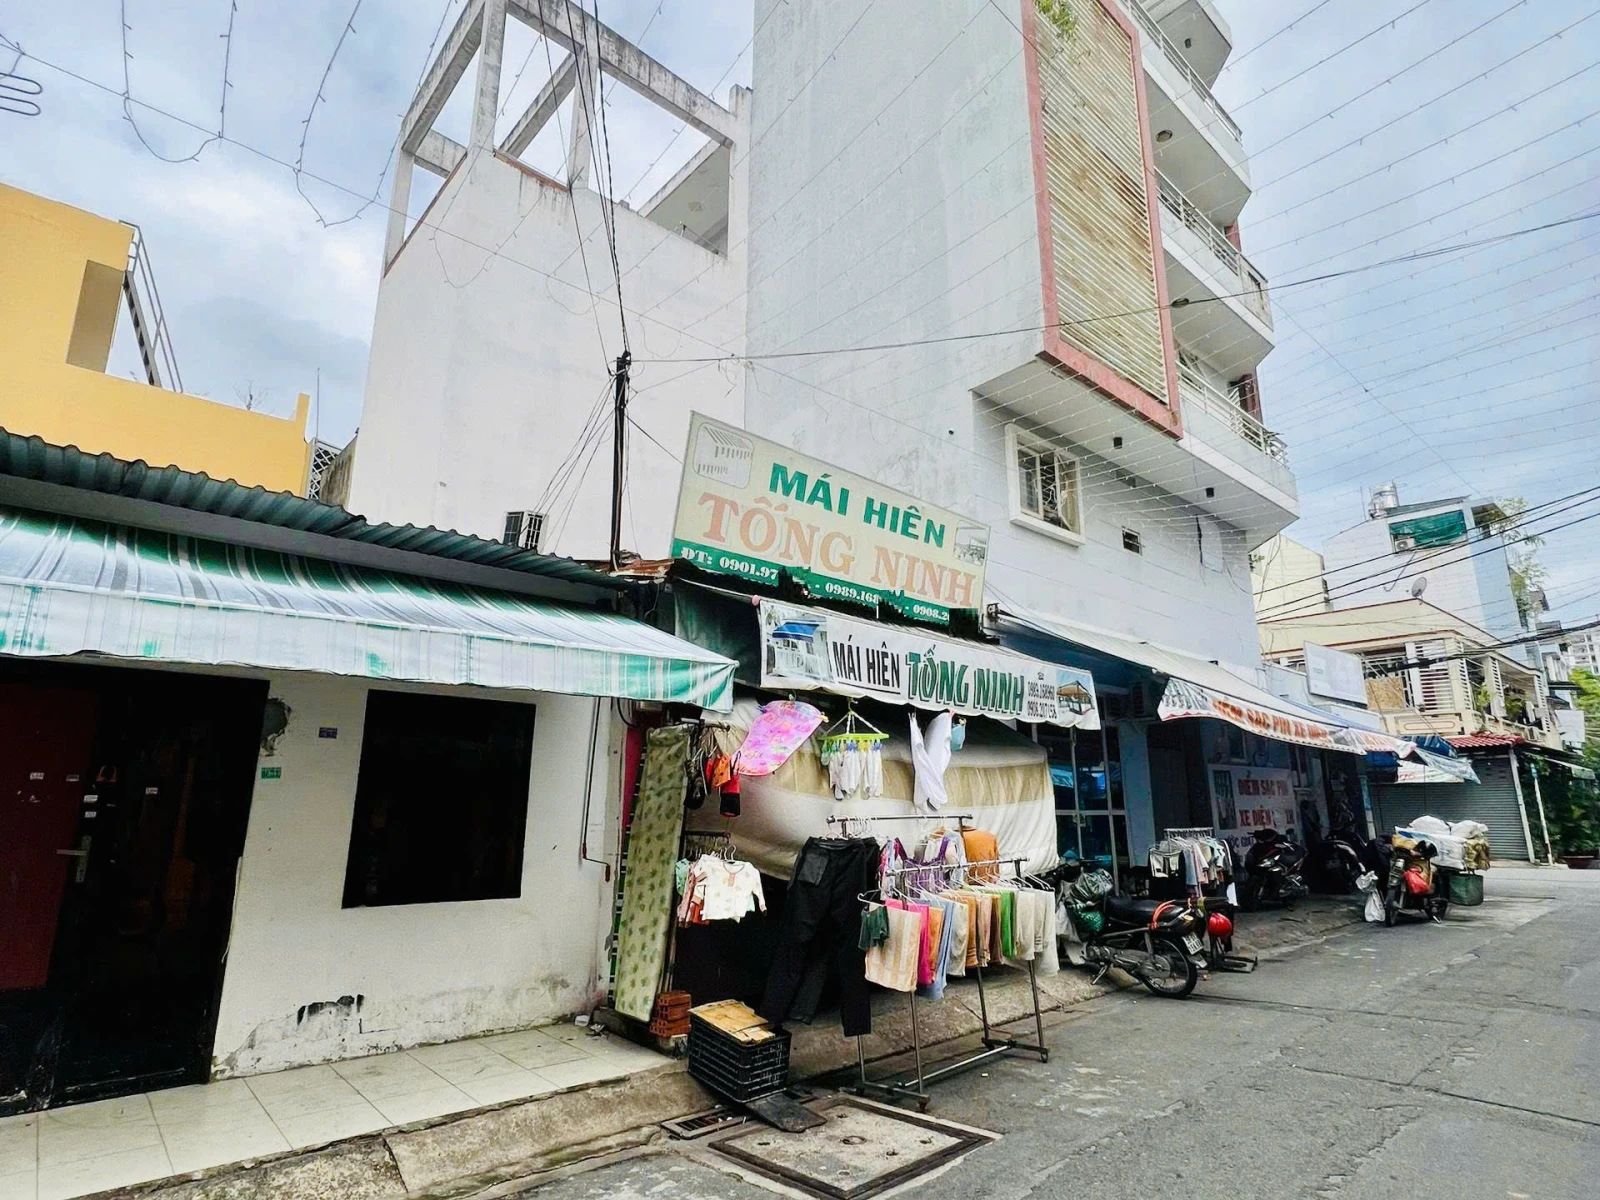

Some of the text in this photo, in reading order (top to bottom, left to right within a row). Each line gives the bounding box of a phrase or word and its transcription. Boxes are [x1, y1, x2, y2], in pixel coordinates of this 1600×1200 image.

[769, 462, 945, 548] MÁI HIÊN
[698, 491, 977, 608] TỐNG NINH
[832, 634, 1025, 716] MÁI HIÊN TỐNG NINH
